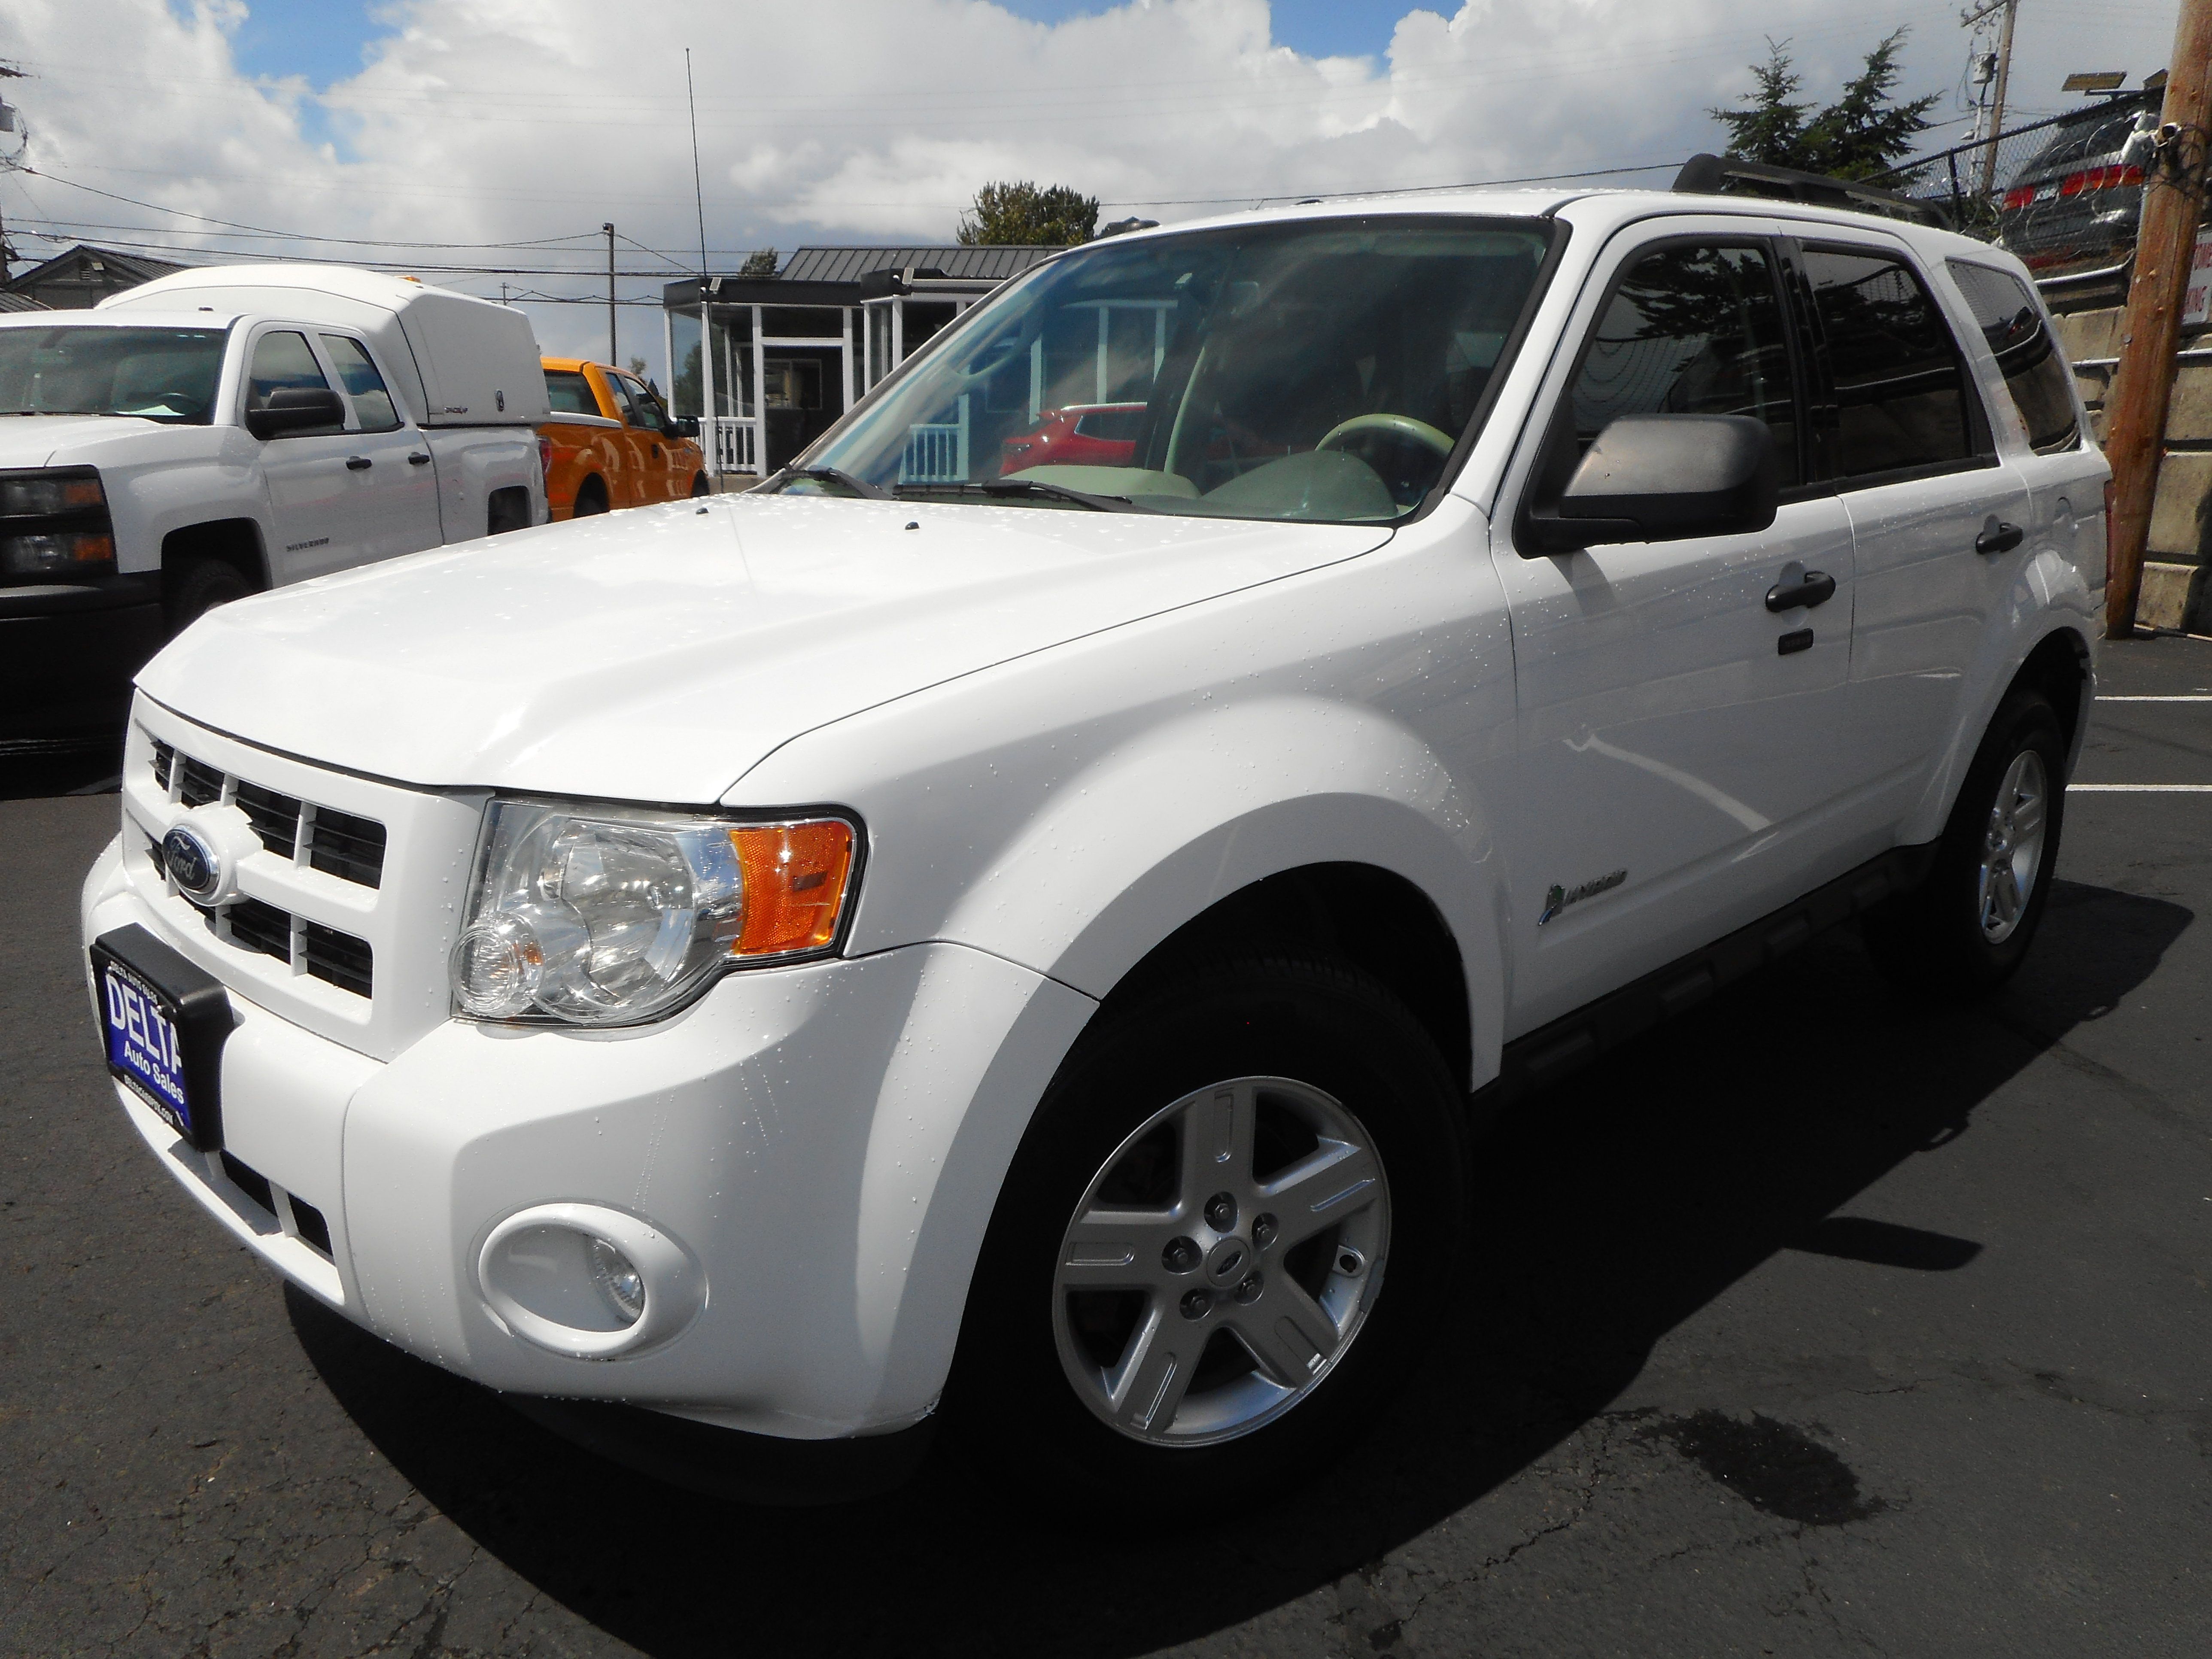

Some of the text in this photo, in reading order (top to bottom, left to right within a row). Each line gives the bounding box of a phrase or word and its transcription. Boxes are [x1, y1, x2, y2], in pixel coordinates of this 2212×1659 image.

[286, 537, 329, 552] SILVERADO
[167, 836, 198, 880] Ford
[106, 973, 182, 1074] DELTA
[124, 1040, 185, 1105] Auto Sales
